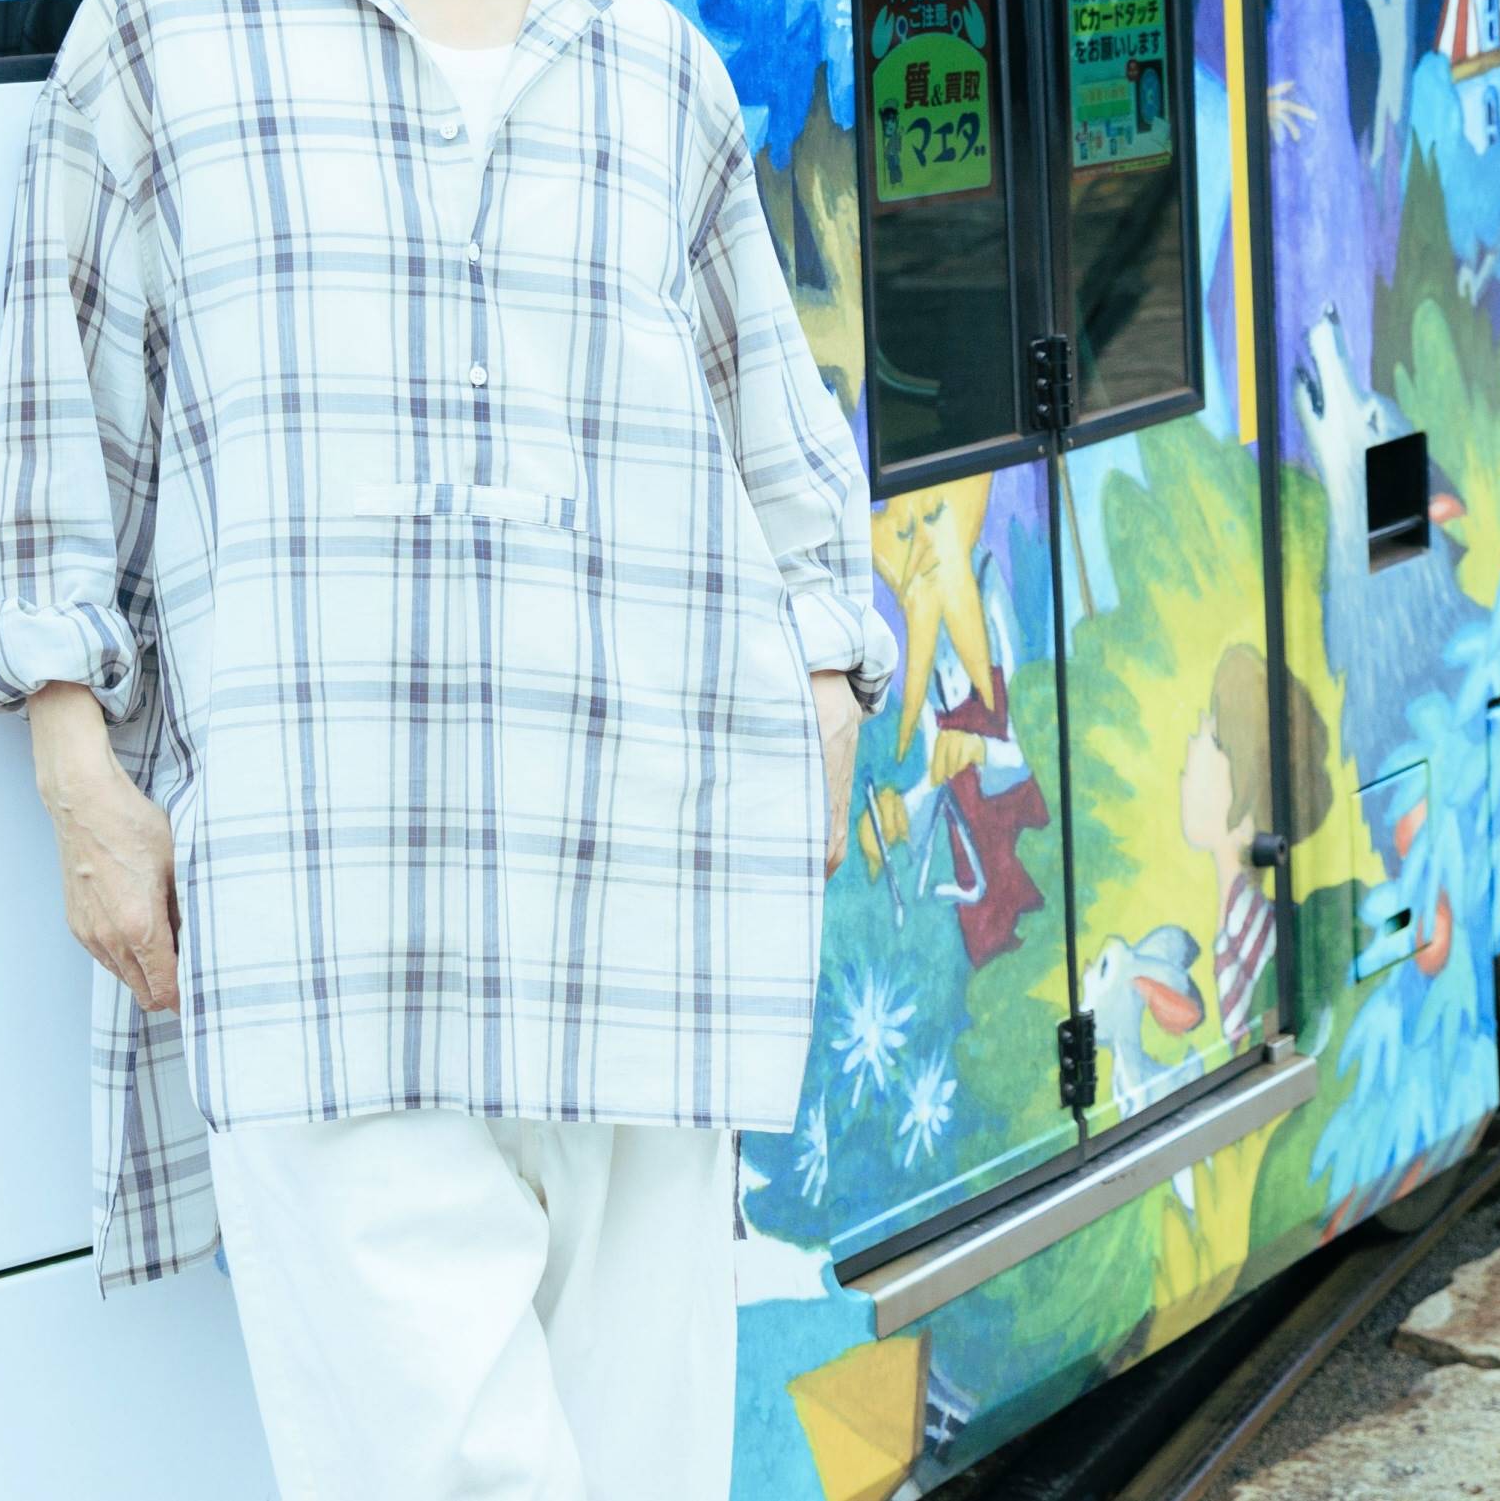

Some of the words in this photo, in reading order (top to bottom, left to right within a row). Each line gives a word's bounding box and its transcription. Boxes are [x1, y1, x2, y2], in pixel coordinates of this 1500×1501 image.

[908, 3, 949, 29] ご注意
[1074, 0, 1159, 32] ICカードタッチ
[1075, 29, 1162, 64] をお願いします
